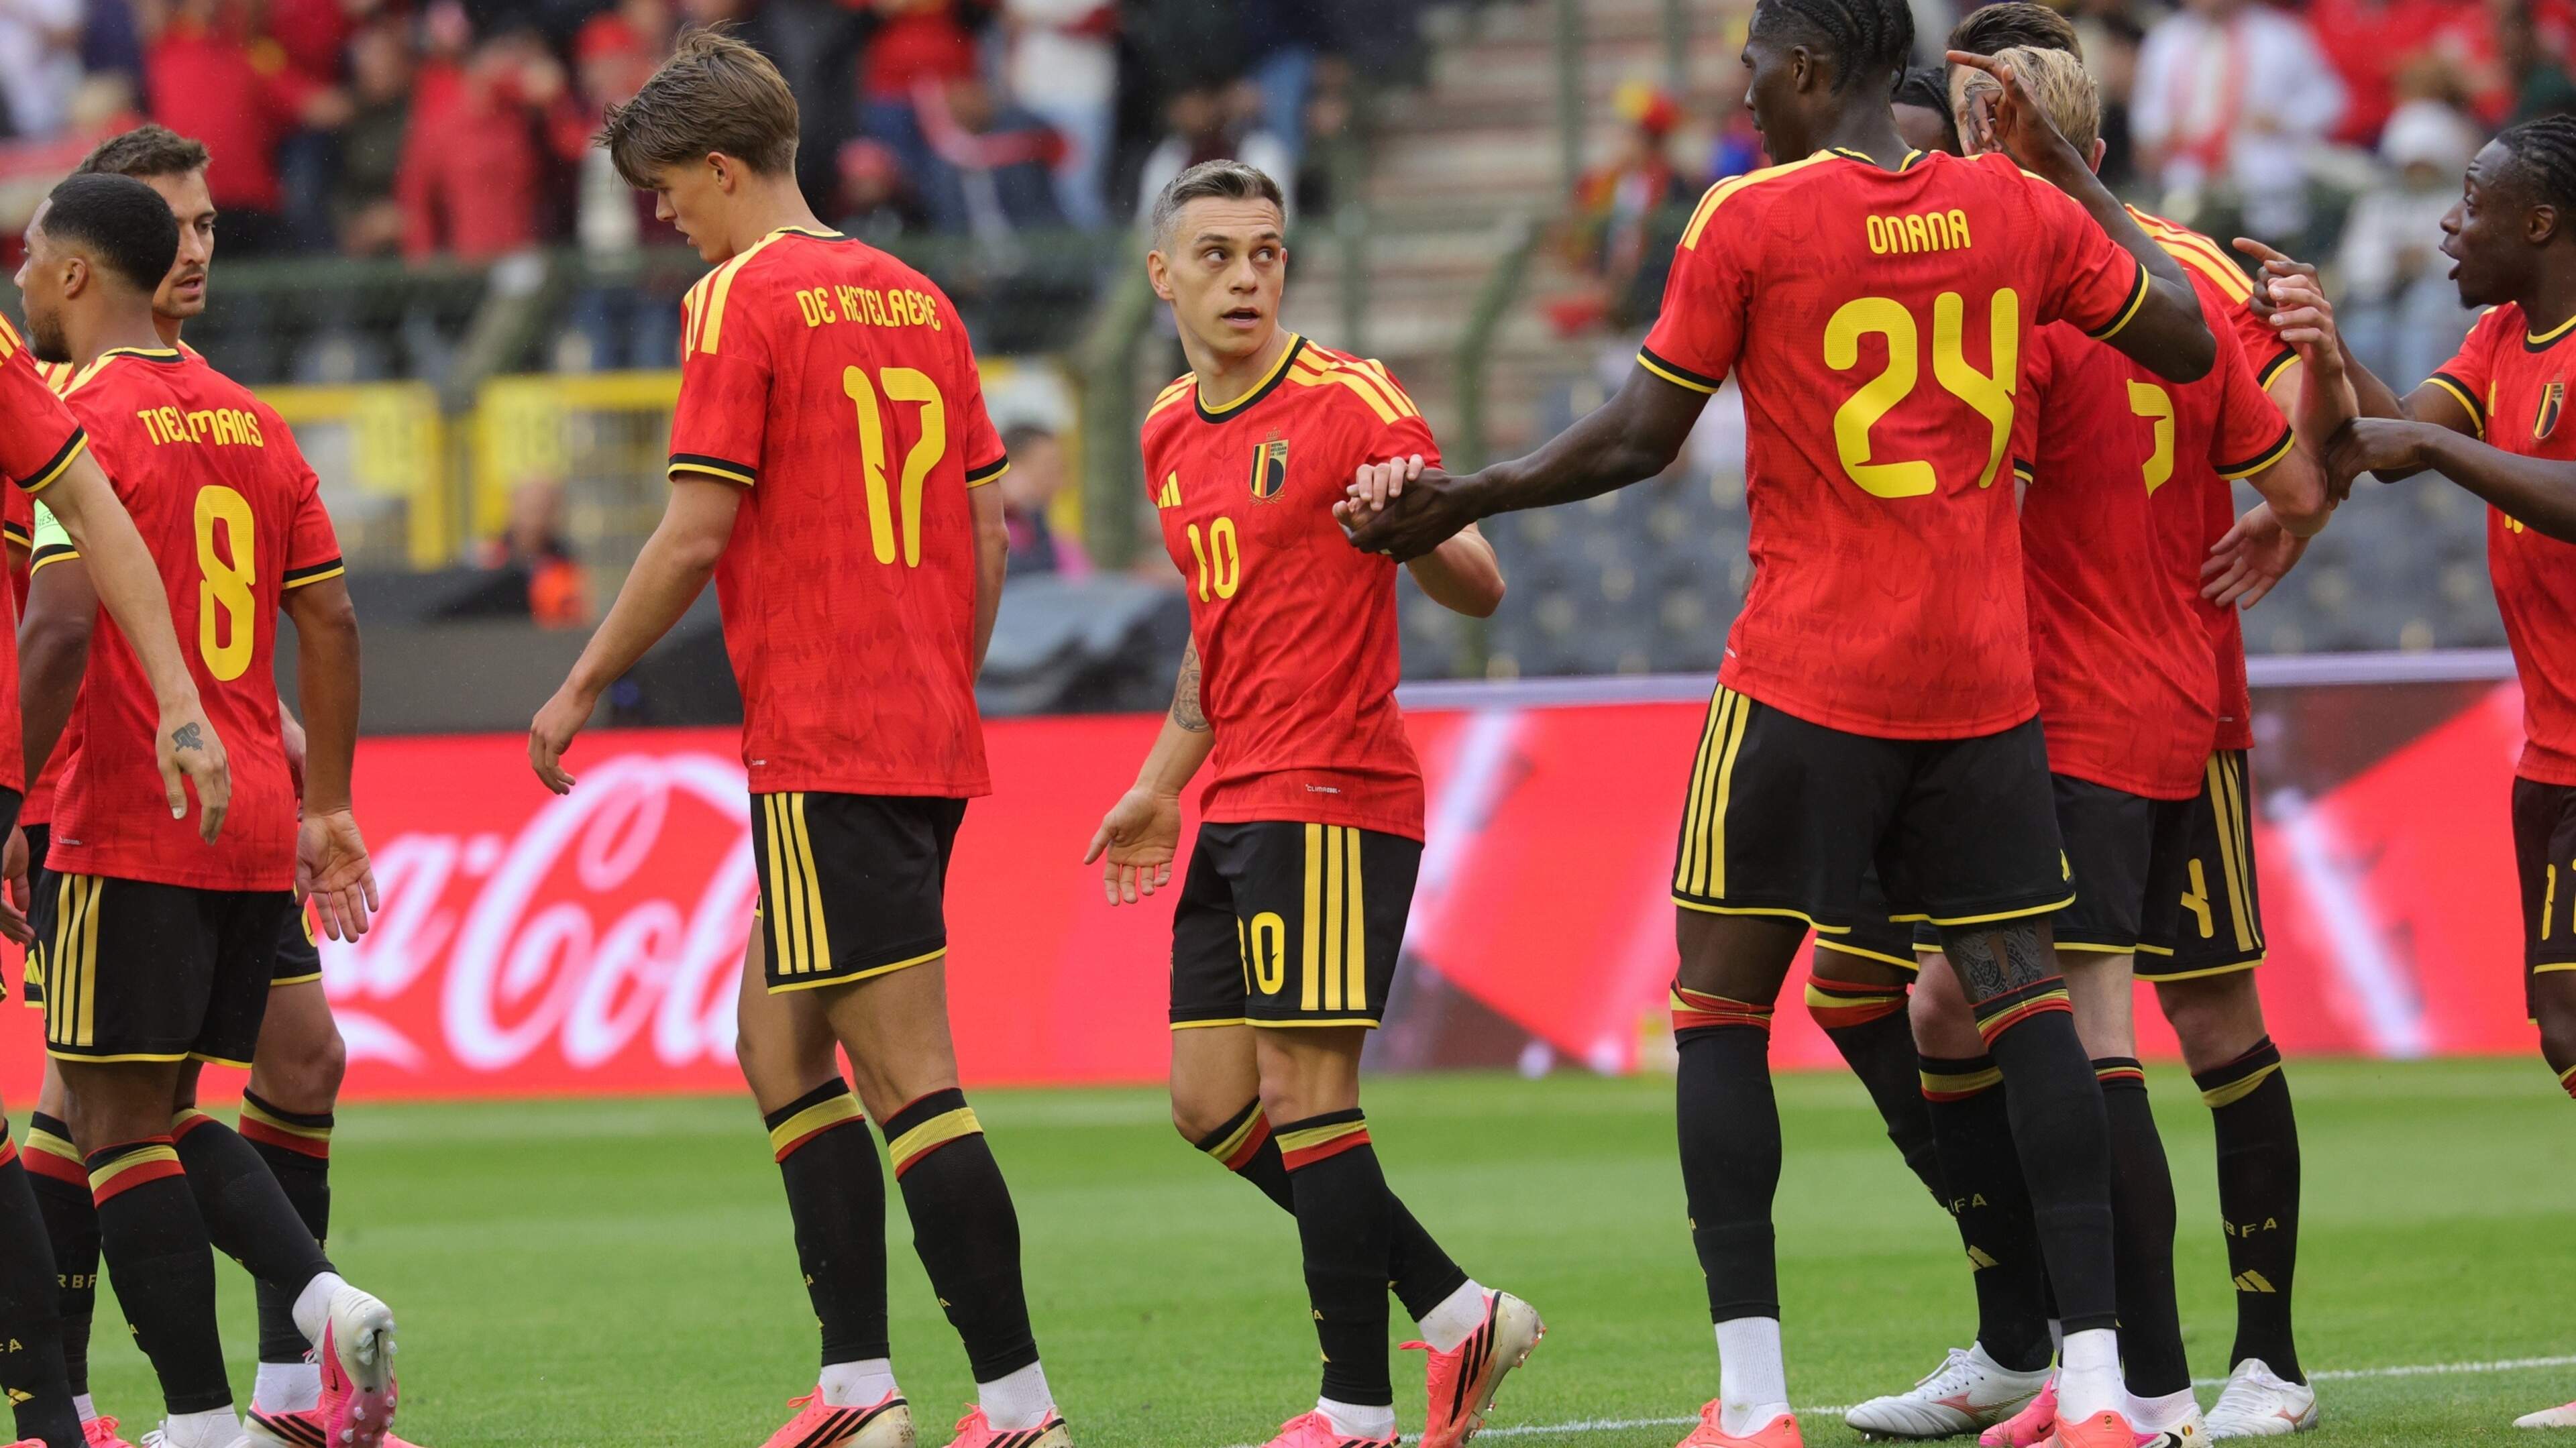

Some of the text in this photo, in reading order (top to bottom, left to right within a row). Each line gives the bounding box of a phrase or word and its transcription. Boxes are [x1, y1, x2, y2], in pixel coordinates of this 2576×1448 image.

[1866, 209, 1972, 254] ONANA
[796, 287, 837, 327] DE
[1824, 288, 2019, 498] 24
[843, 365, 945, 568] 17
[2127, 378, 2175, 500] 7
[194, 485, 256, 681] 8
[1187, 516, 1240, 603] 10
[2541, 858, 2576, 940] 1
[2221, 1215, 2277, 1238] BFA
